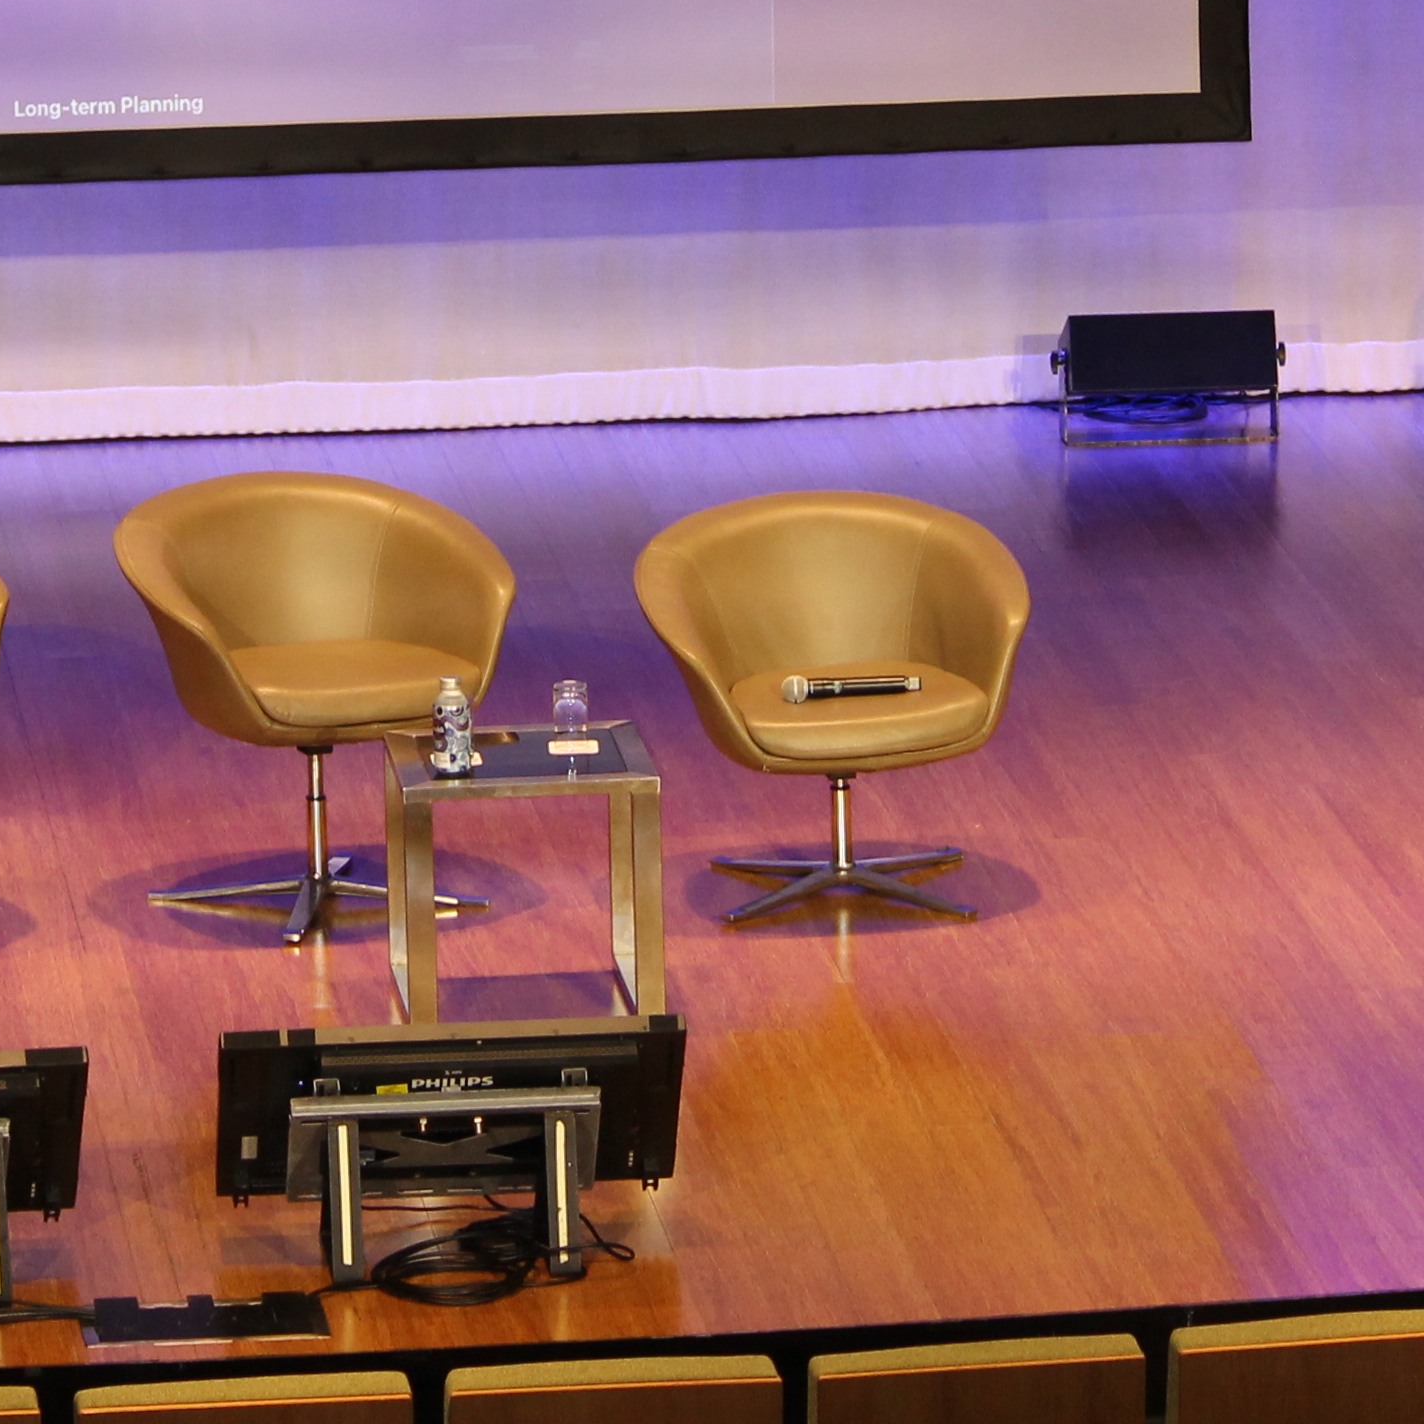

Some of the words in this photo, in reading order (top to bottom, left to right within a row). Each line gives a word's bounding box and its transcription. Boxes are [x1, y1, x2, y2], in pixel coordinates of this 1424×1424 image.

[14, 98, 116, 120] Long-term
[120, 93, 204, 115] Planning
[410, 1075, 495, 1090] PHILIPS
